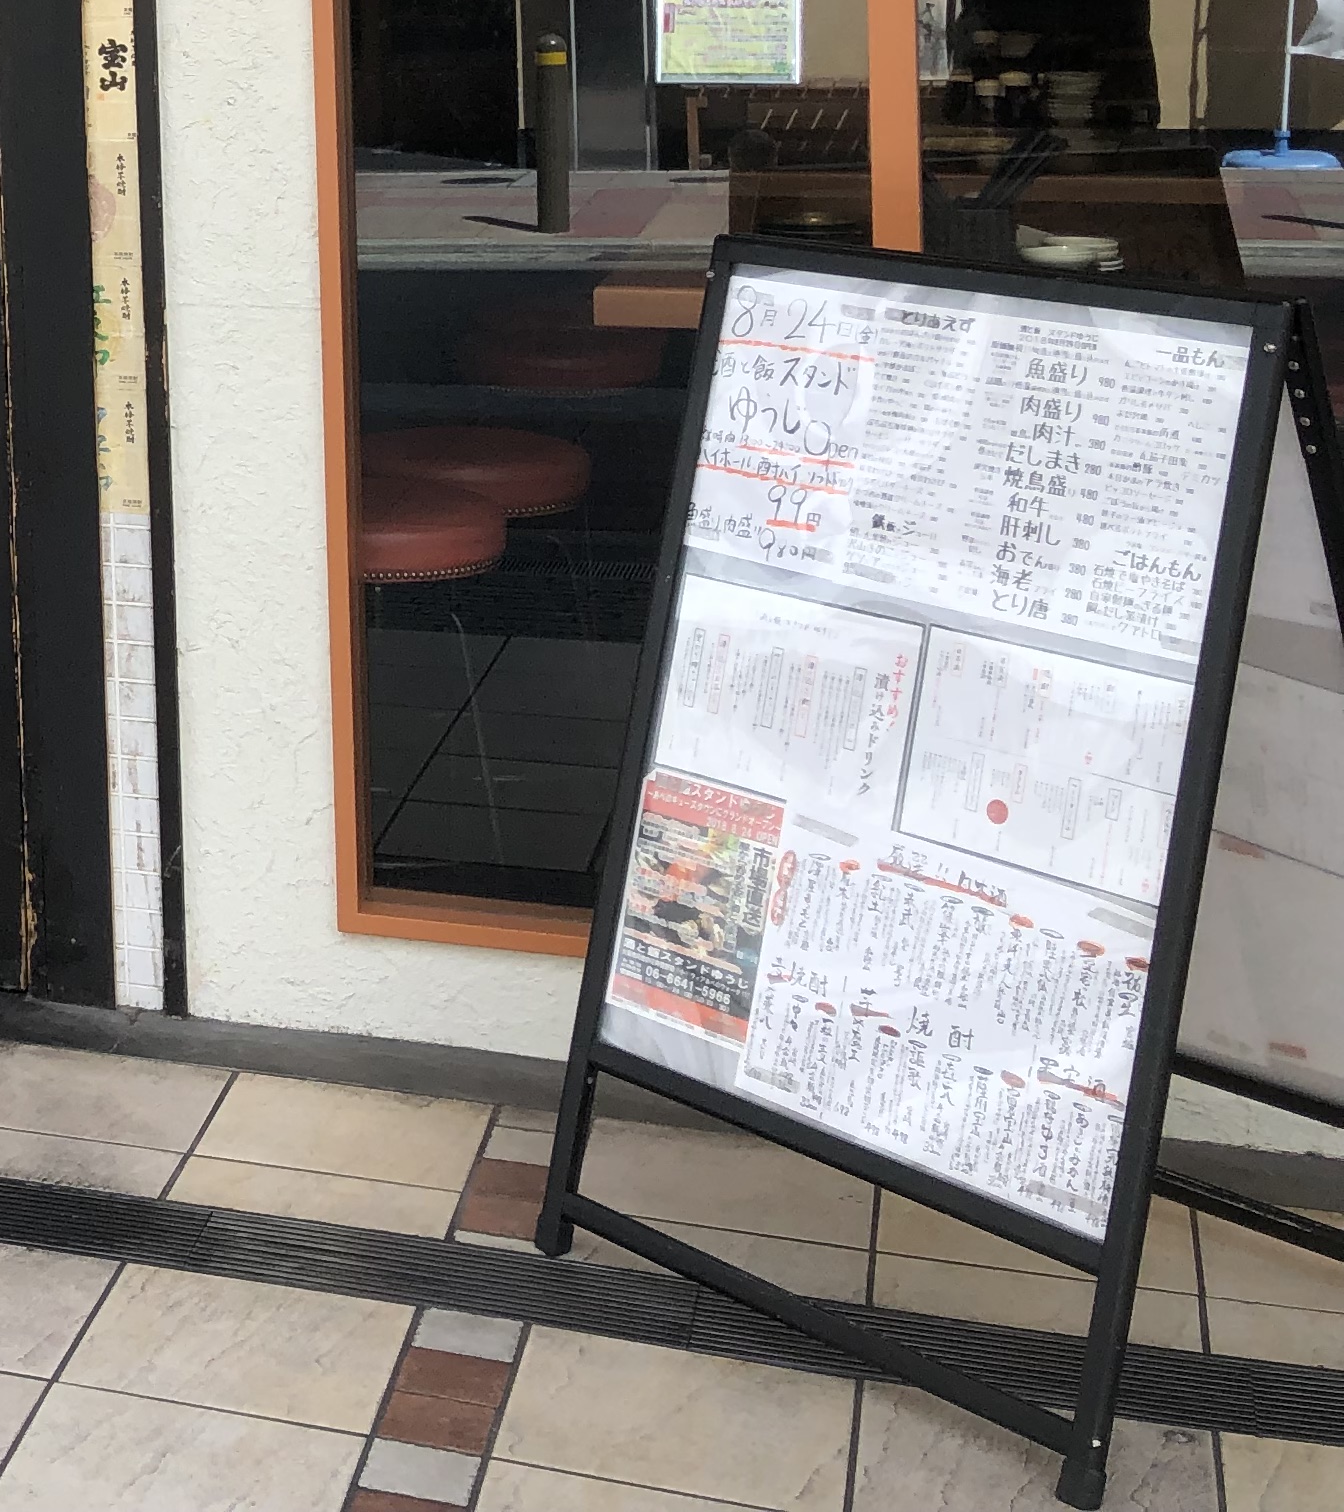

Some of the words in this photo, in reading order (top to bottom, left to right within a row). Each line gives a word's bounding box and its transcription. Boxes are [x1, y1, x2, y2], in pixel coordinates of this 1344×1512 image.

[97, 38, 128, 92] 宝山
[1025, 357, 1088, 386] 魚盛り
[1155, 346, 1225, 368] 一品もん
[1020, 395, 1082, 423] 肉盛り
[1005, 441, 1081, 474] だしまき
[1007, 492, 1050, 518] 和牛
[999, 514, 1061, 547] 肝刺し
[1112, 549, 1202, 582] ごはんもん
[991, 588, 1050, 620] とり唐
